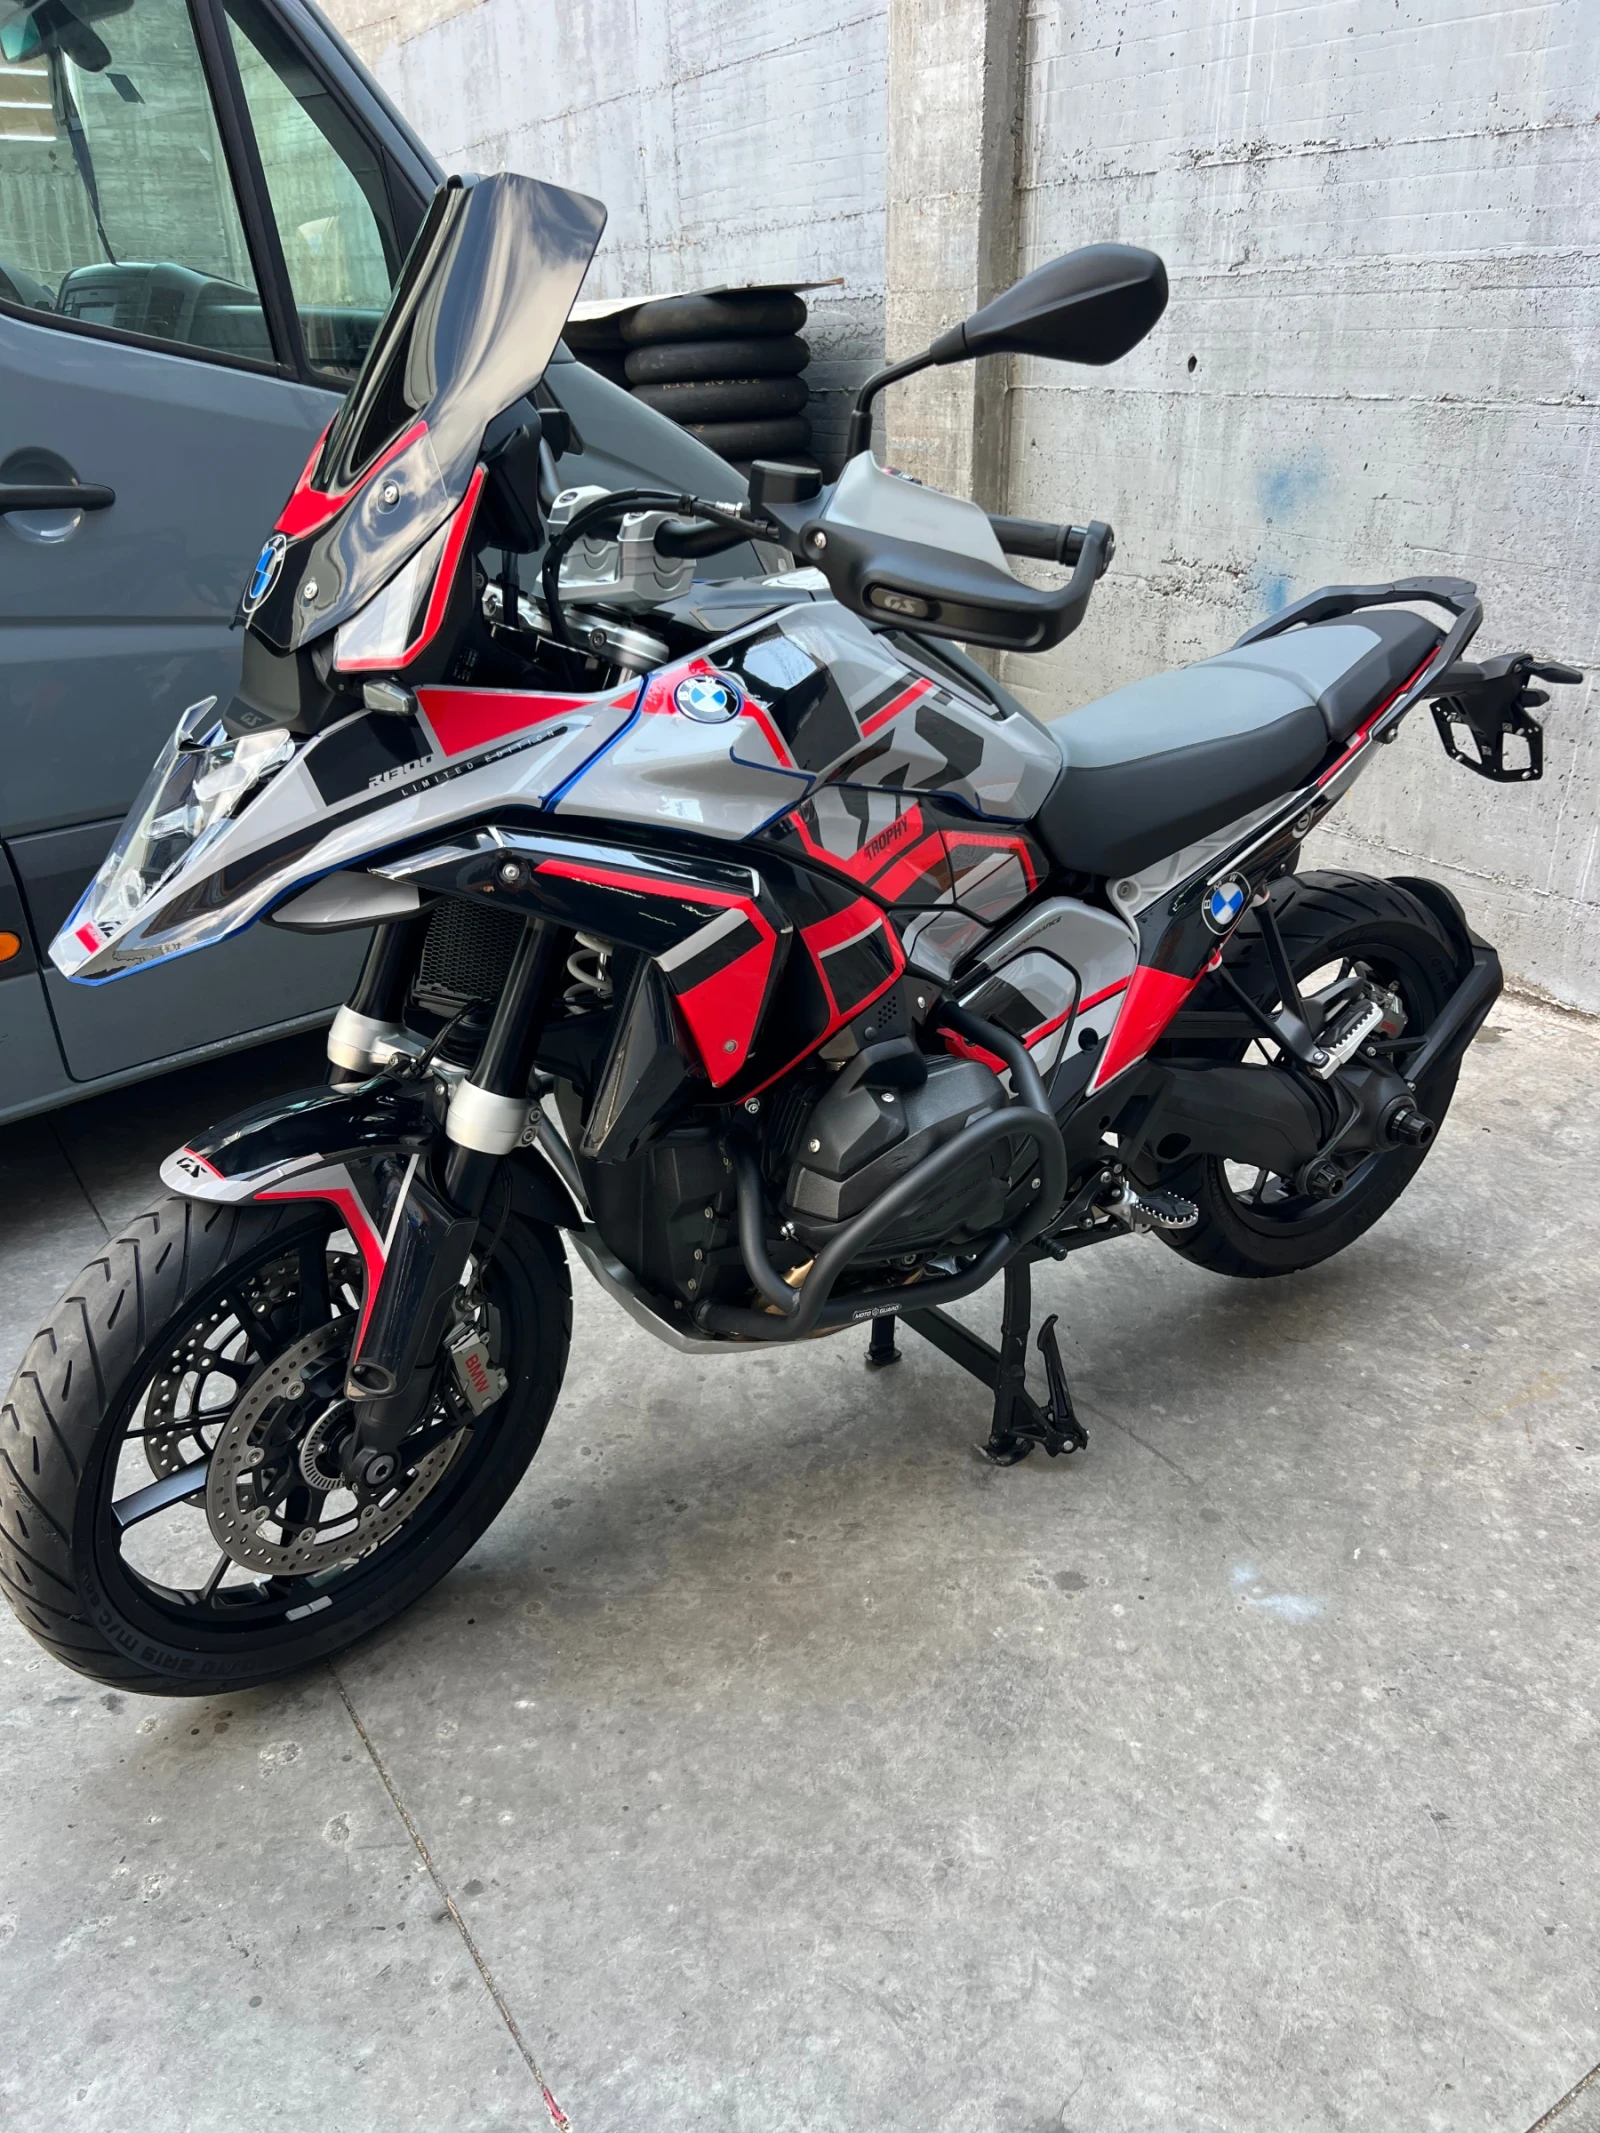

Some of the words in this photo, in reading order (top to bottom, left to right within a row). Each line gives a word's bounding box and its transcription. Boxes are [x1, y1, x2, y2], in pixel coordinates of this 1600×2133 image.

[884, 595, 916, 613] GS
[368, 755, 433, 790] R1300
[401, 762, 474, 797] LIMITED
[484, 729, 555, 763] EDITION
[863, 817, 909, 861] TROPHY
[176, 1156, 208, 1179] GS
[465, 1352, 491, 1394] BMW
